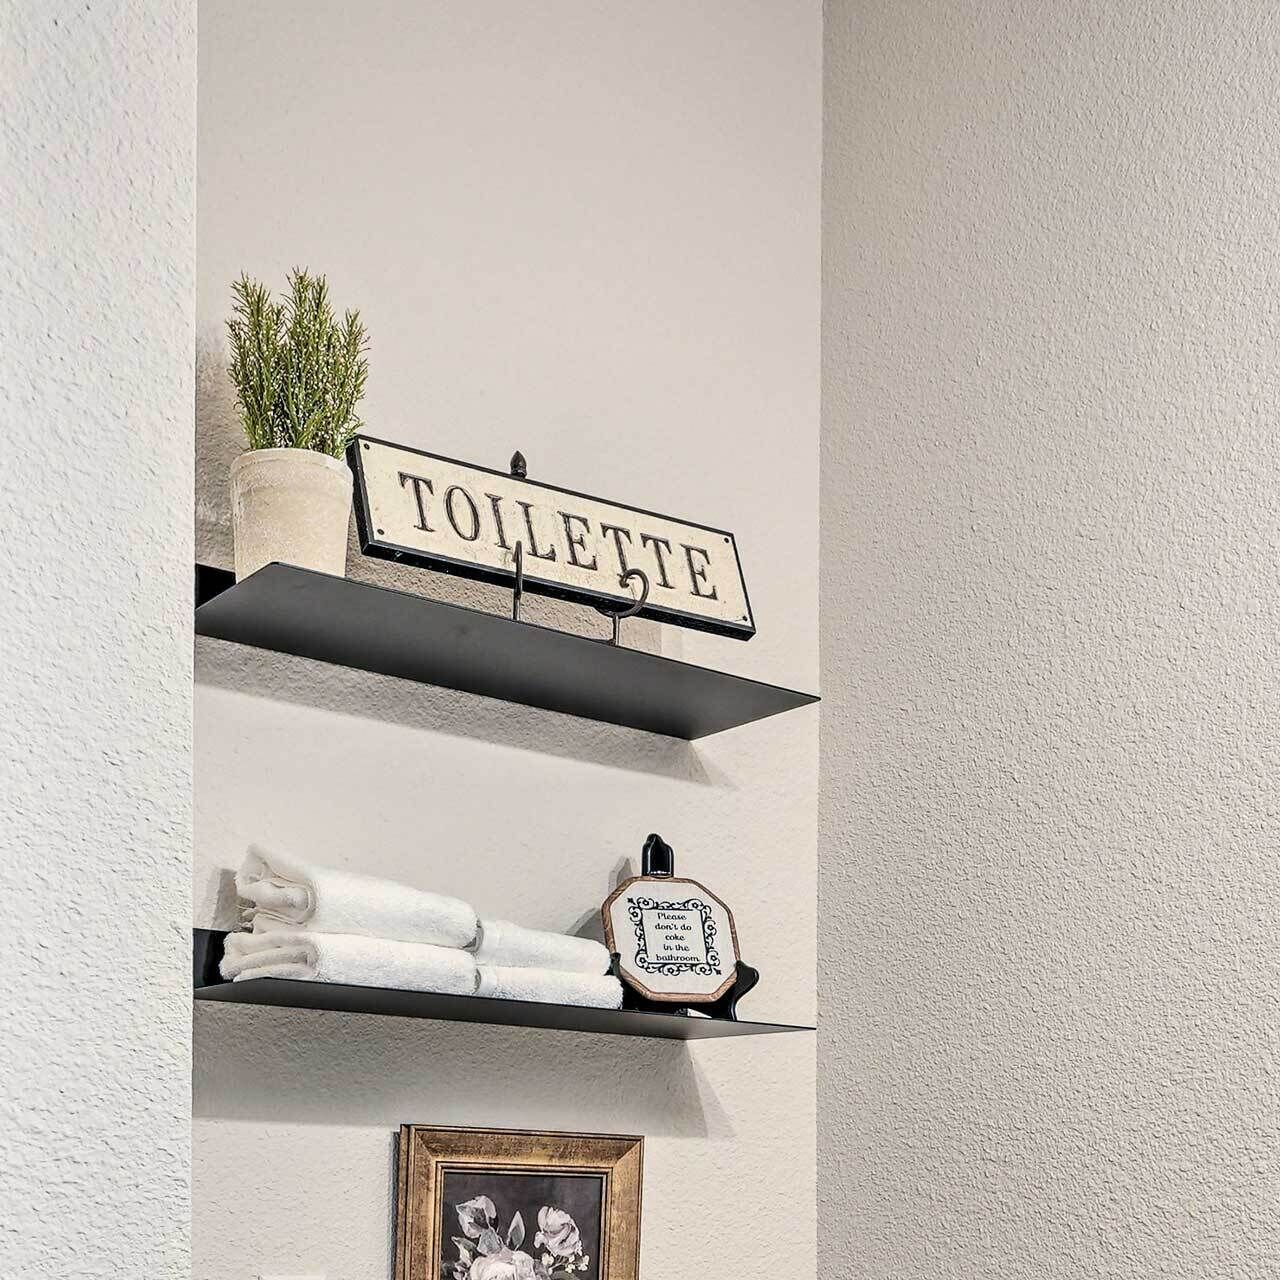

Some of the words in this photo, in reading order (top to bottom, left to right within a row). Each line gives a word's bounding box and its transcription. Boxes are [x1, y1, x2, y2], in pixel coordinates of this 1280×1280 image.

[397, 471, 719, 601] TOILETTE
[657, 912, 687, 920] Please
[655, 922, 678, 930] don't
[680, 923, 692, 931] do
[665, 933, 685, 941] coke
[663, 943, 674, 951] in
[675, 943, 690, 951] the
[656, 953, 701, 962] bathroom
